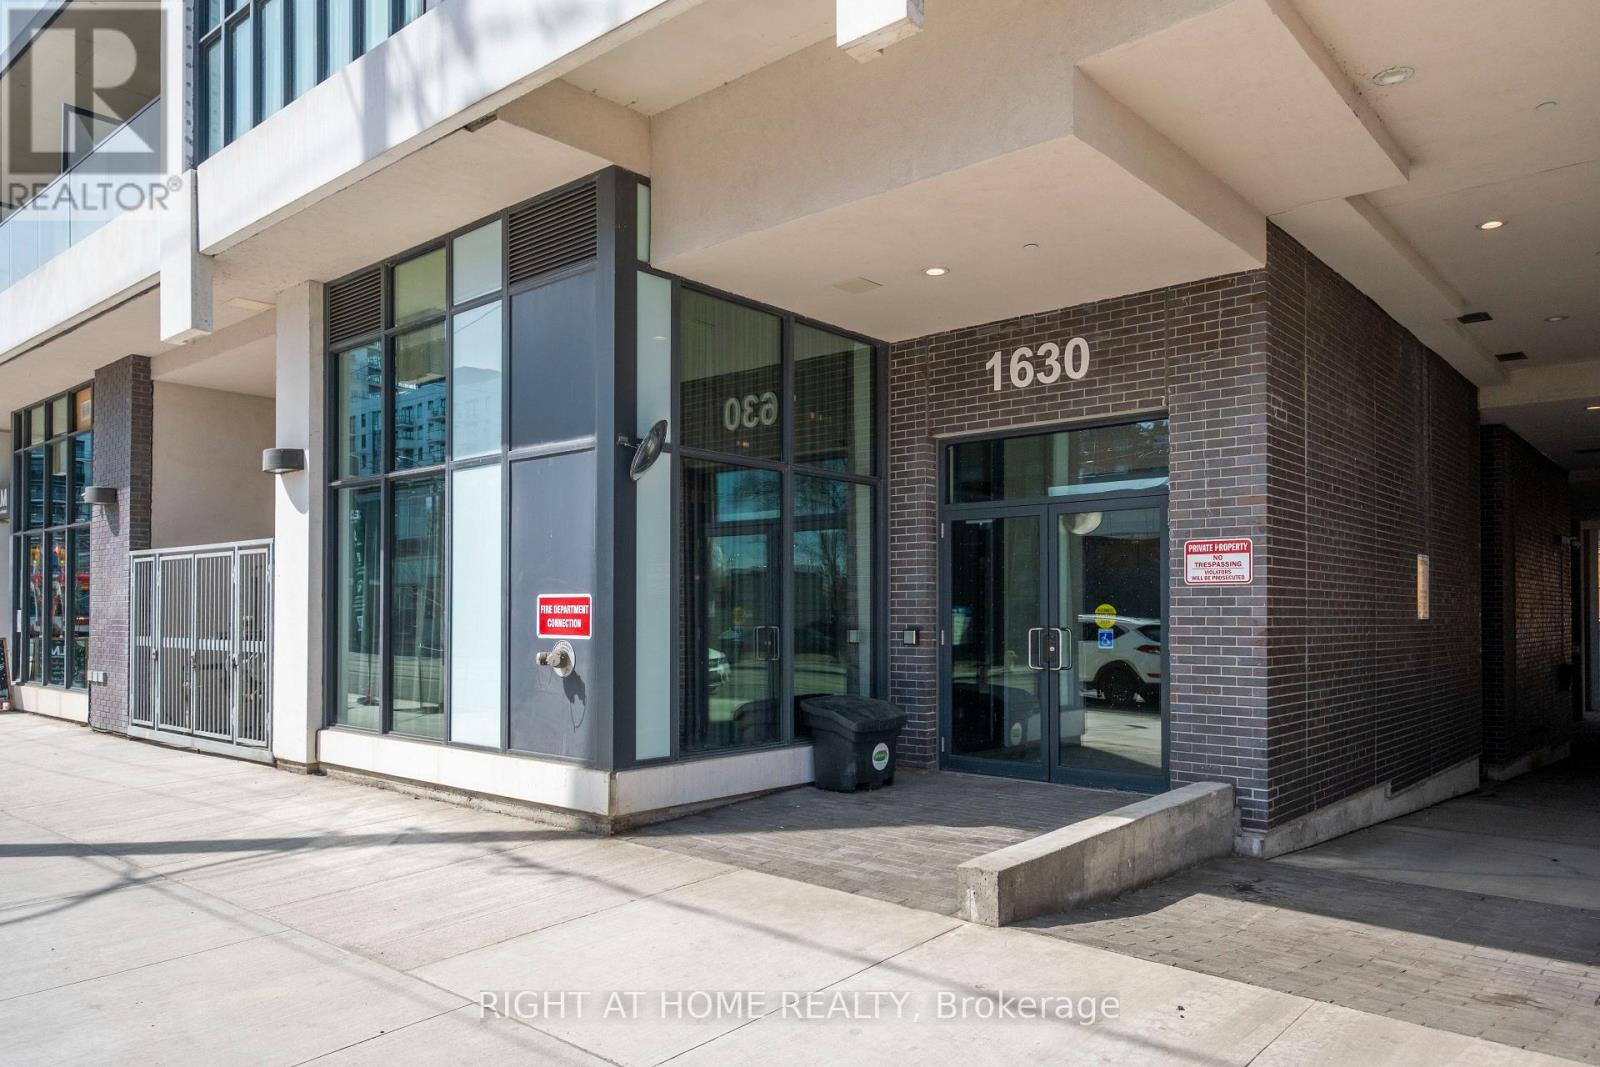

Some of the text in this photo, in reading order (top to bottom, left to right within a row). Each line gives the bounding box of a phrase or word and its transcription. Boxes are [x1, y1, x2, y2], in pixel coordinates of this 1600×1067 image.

[985, 337, 1090, 391] 1630
[1188, 543, 1248, 552] PRIVATE PROPERTY
[540, 604, 589, 614] FIRE DEPARTMENT
[547, 618, 581, 628] CONNECTION
